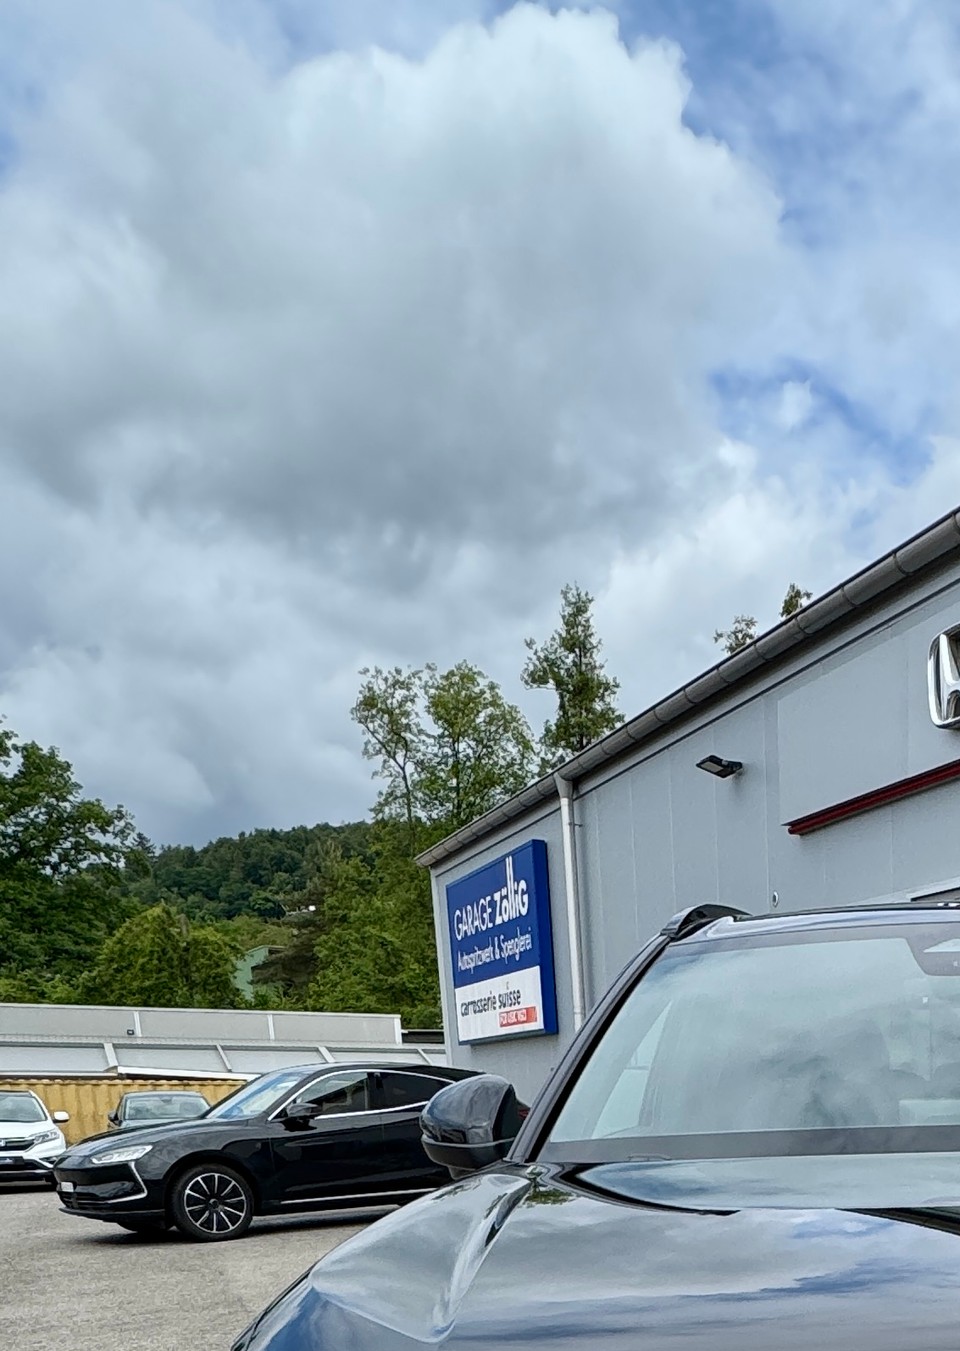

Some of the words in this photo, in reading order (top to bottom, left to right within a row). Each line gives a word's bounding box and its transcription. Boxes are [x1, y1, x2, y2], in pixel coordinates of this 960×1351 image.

[454, 896, 493, 941] GARAGE
[494, 936, 500, 960] &
[500, 926, 532, 965] Spenglerei
[460, 990, 497, 1018] carrosserie
[498, 983, 521, 1010] suisse
